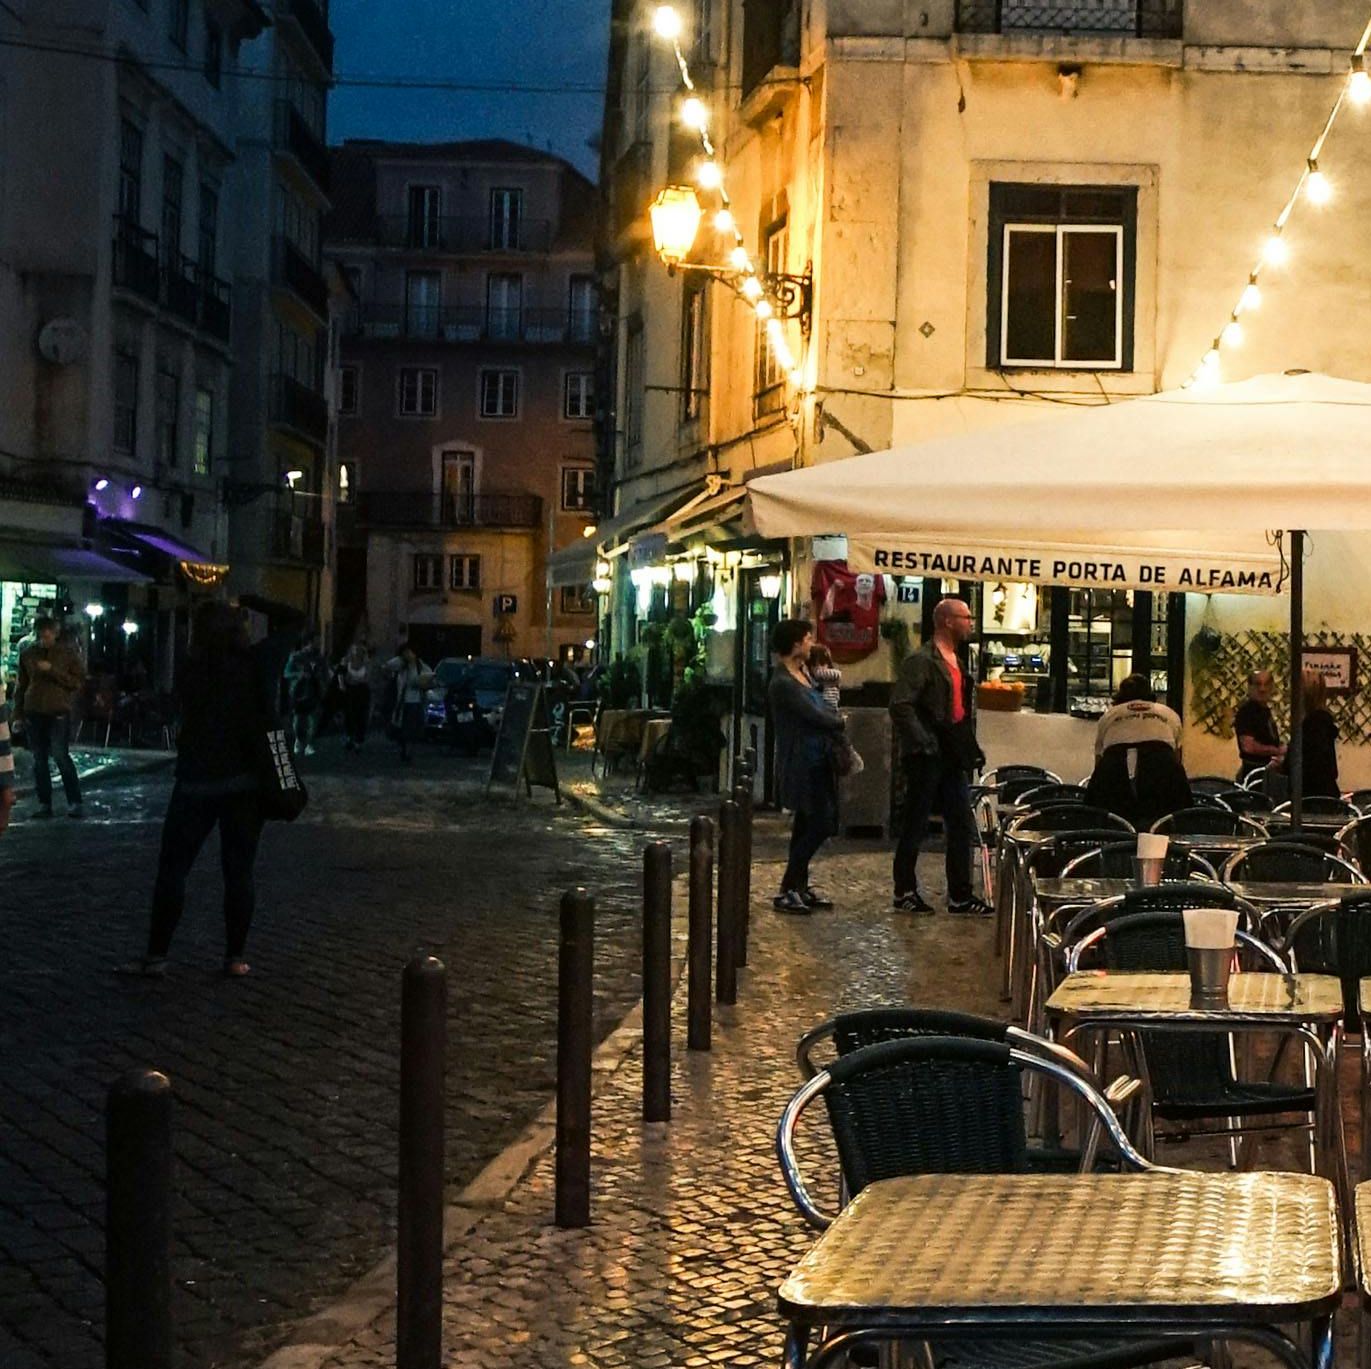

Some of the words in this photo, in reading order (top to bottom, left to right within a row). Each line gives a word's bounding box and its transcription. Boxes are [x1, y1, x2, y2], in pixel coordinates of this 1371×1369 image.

[874, 549, 1041, 577] RESTAURANTE
[1053, 560, 1127, 582] PORTA
[1139, 565, 1166, 584] DE
[1178, 568, 1273, 590] ALFAMA
[501, 596, 514, 611] P
